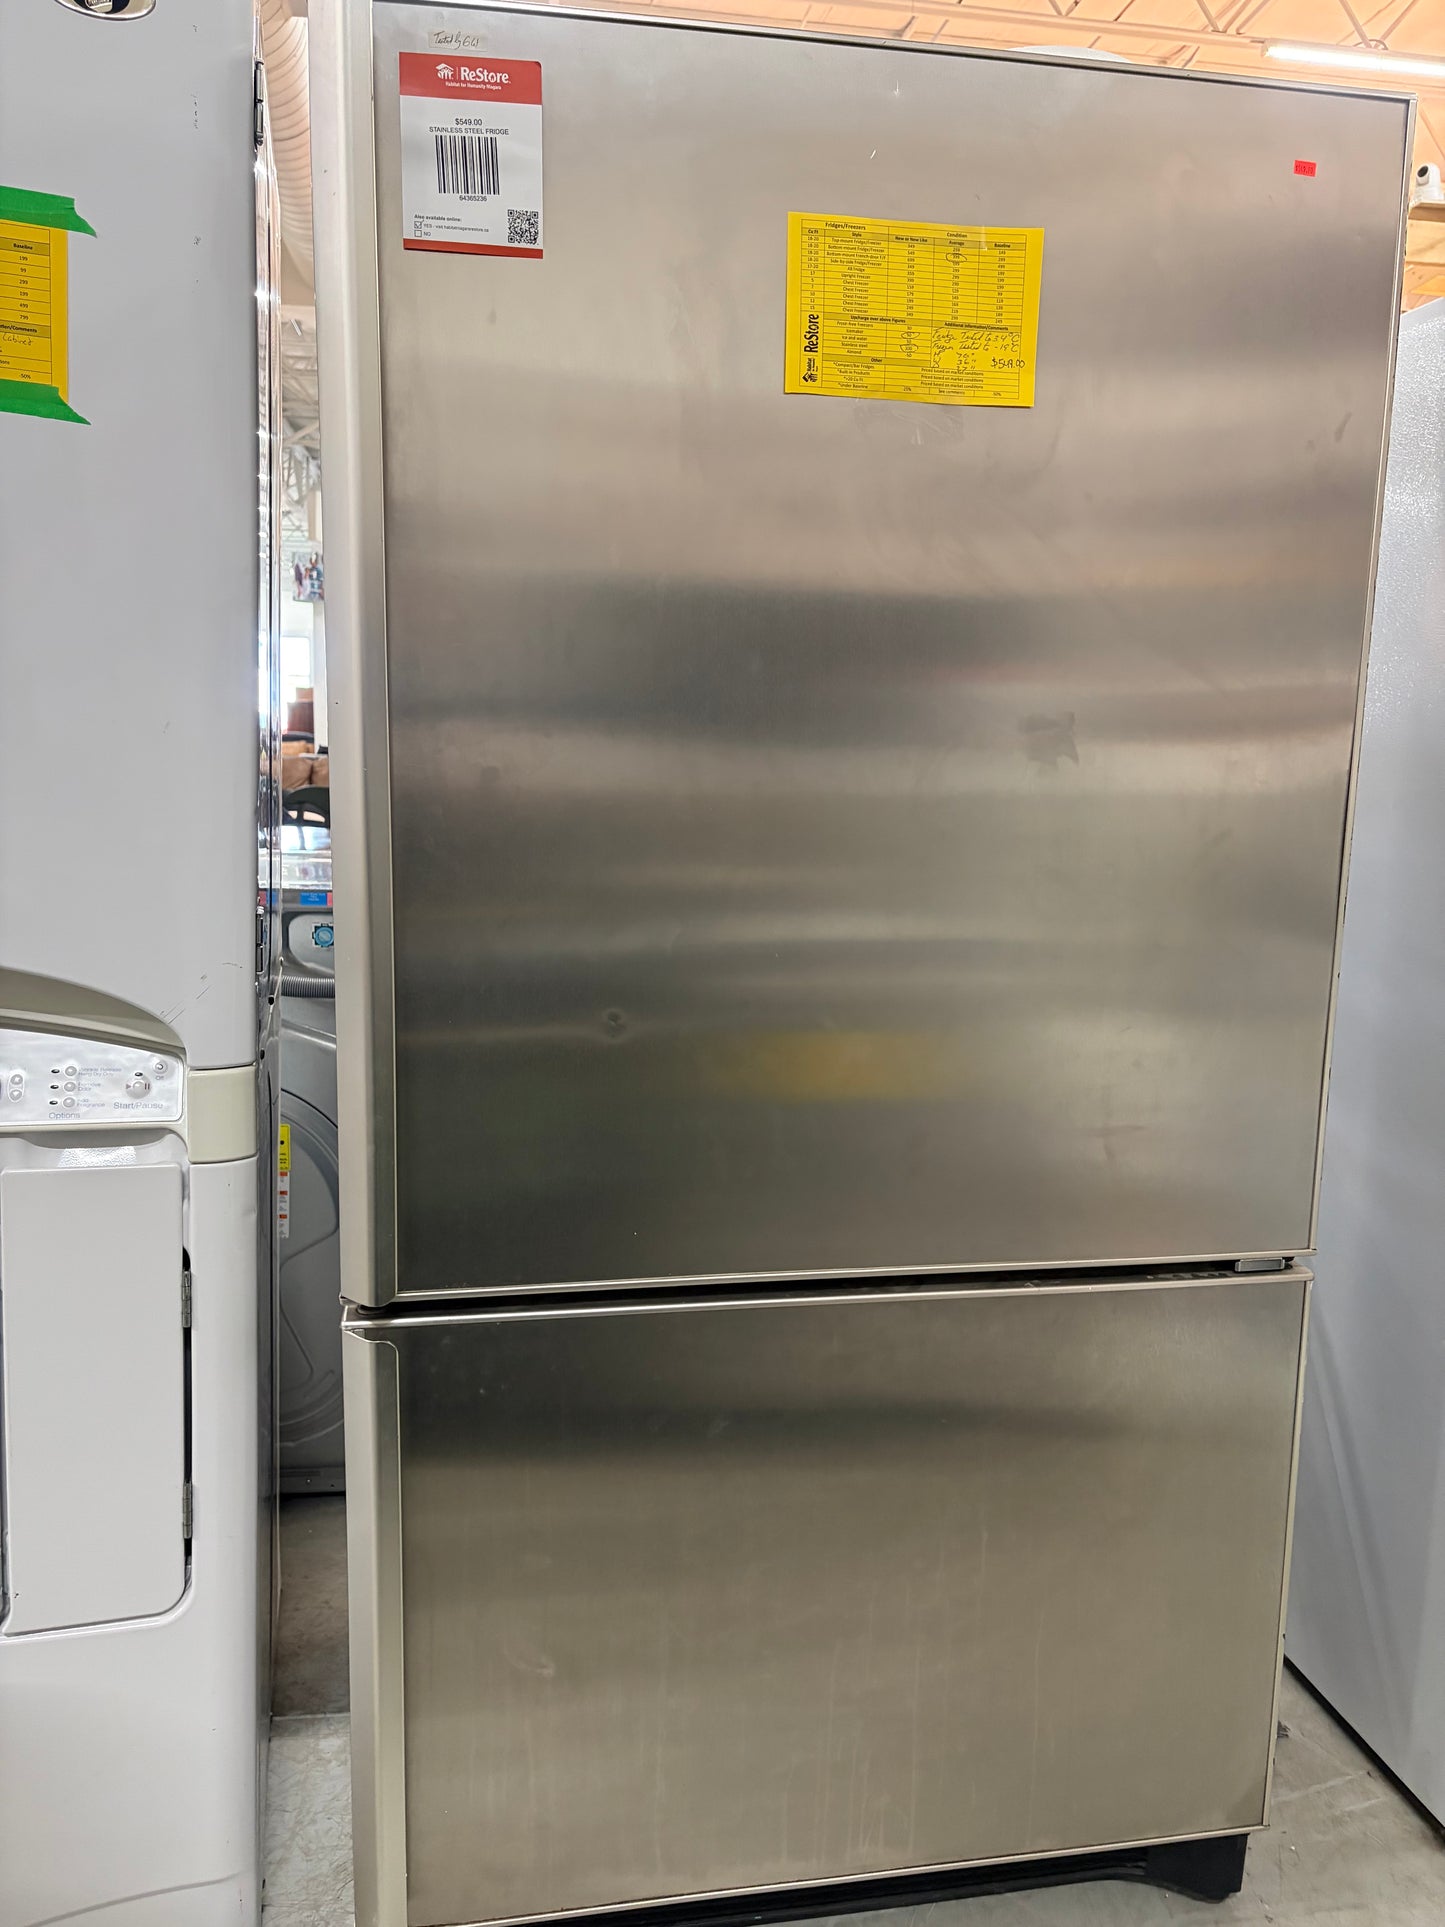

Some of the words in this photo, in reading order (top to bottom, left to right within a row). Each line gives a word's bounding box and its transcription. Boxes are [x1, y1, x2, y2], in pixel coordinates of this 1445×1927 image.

[460, 66, 509, 84] ReStore
[455, 118, 482, 126] $549.00
[429, 126, 463, 134] STAINLESS
[486, 128, 510, 136] FRIDGE
[825, 222, 866, 230] Fridges/Freezers
[13, 242, 33, 250] Baseline
[804, 314, 820, 353] ReStore
[990, 356, 1026, 369] $549.00
[48, 1112, 80, 1120] Options
